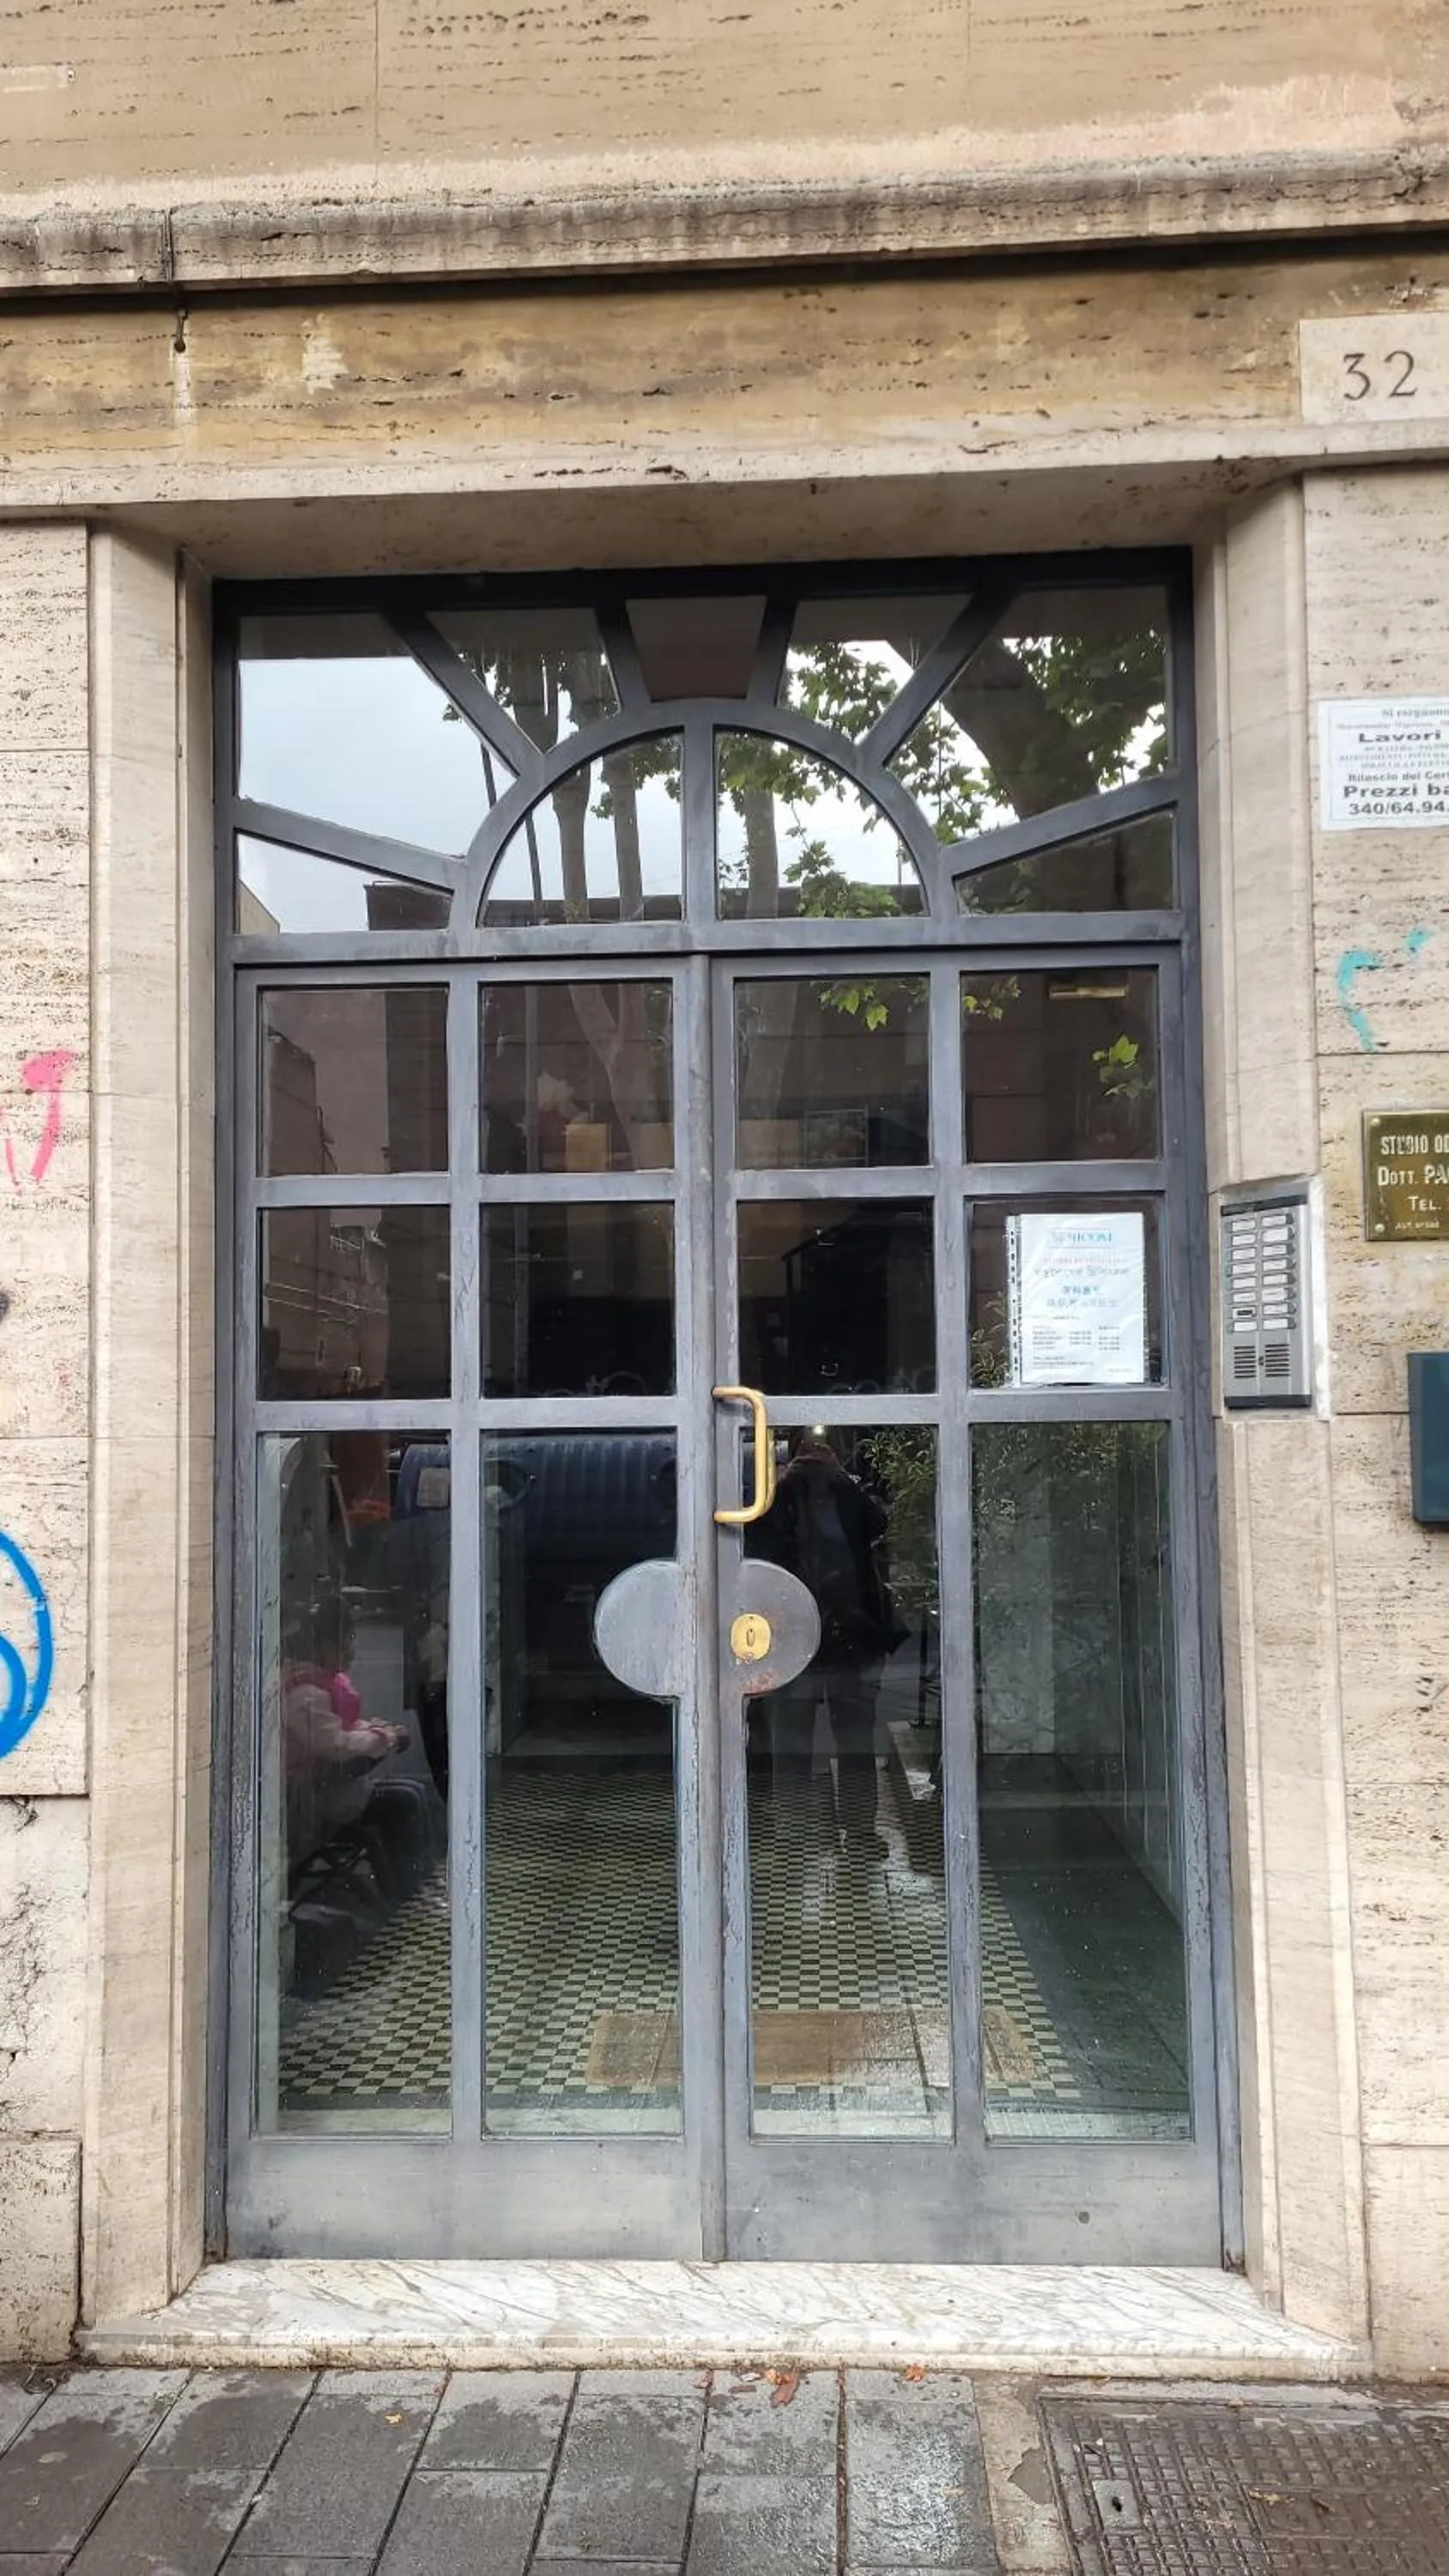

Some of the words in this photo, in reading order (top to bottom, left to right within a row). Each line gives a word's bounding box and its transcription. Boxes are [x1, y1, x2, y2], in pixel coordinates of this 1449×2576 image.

[1343, 350, 1417, 400] 32
[1359, 730, 1441, 743] Lavori
[1343, 783, 1418, 798] Prezzi
[1380, 1134, 1429, 1155] STUDIO
[1424, 1163, 1449, 1185] PA
